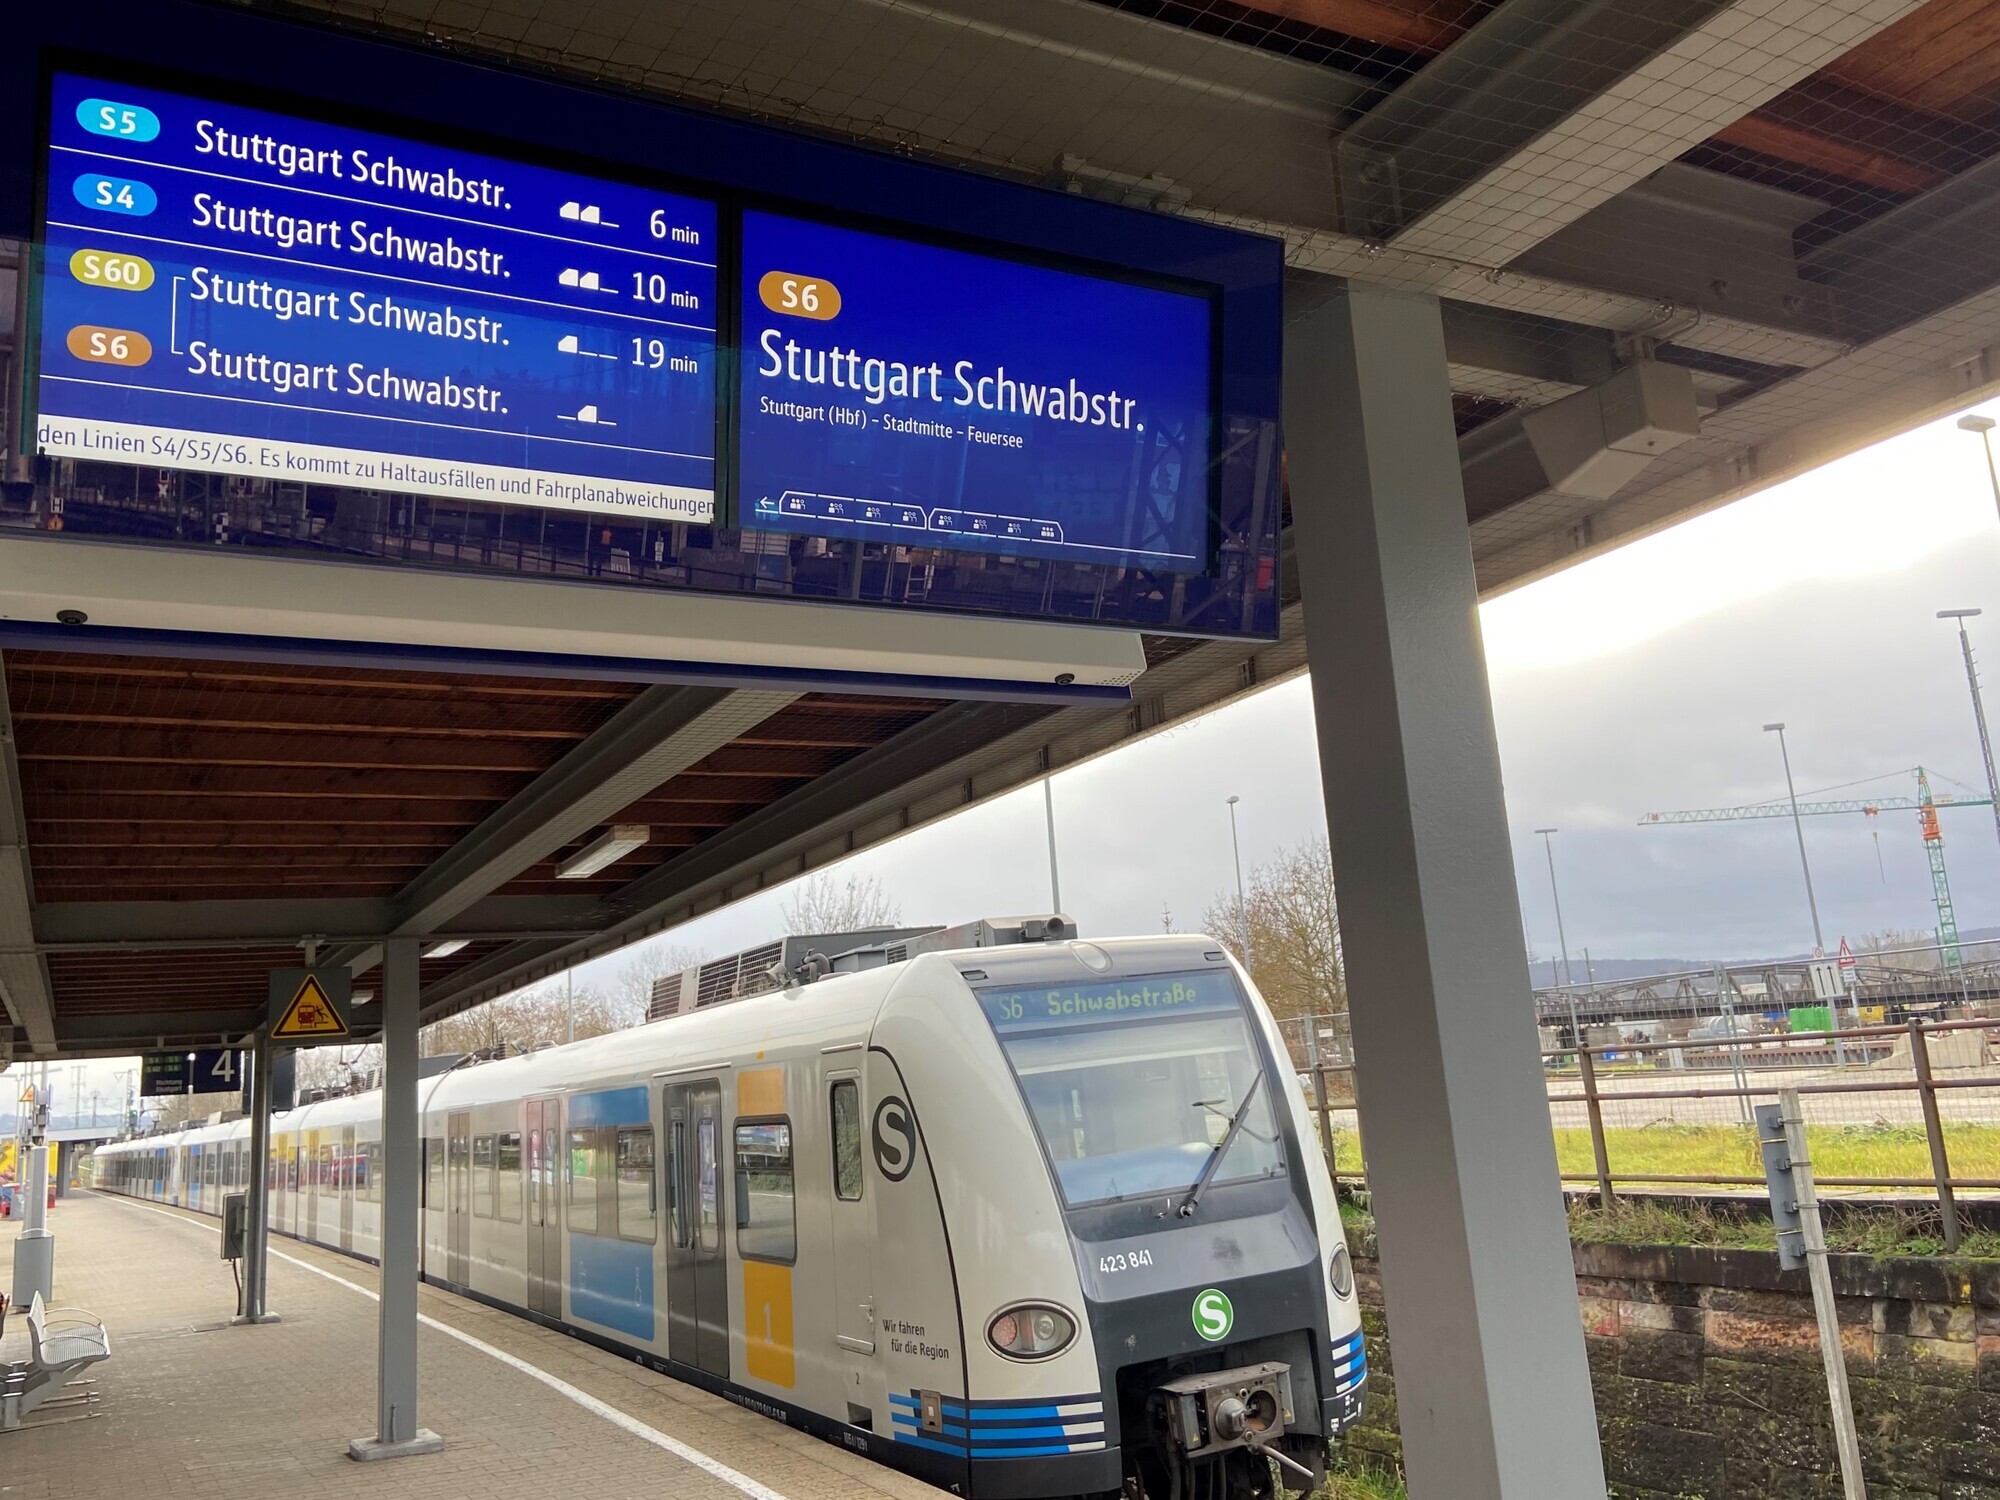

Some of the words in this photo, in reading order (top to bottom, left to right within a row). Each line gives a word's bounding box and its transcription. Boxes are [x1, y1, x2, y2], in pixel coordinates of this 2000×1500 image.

[100, 106, 136, 134] S5
[195, 119, 343, 178] Stuttgart
[351, 150, 512, 210] Schwabstr.
[96, 181, 135, 209] S4
[192, 193, 343, 249] Stuttgart
[349, 220, 511, 278] Schwabstr.
[650, 209, 667, 239] 6
[671, 227, 699, 245] min
[83, 255, 142, 287] S60
[190, 266, 340, 321] Stuttgart
[348, 292, 510, 346] Schwabstr.
[632, 272, 666, 304] 10
[671, 290, 699, 310] min
[781, 279, 820, 313] S6
[89, 332, 129, 360] S6
[632, 336, 665, 369] 19
[670, 355, 698, 374] min
[188, 340, 338, 393] Stuttgart
[346, 362, 508, 414] Schwabstr.
[759, 328, 943, 404] Stuttgart
[953, 360, 1145, 432] Schwabstr.
[760, 395, 825, 423] Stuttgart
[828, 404, 868, 430] (Hbf)
[883, 413, 953, 439] Stadtmitte
[968, 425, 1024, 448] Feuersee
[38, 424, 76, 447] den
[83, 428, 145, 453] Linien
[151, 435, 253, 465] S4/S5/S6.
[260, 447, 280, 468] Es
[286, 451, 350, 475] kommt
[355, 464, 375, 479] zu
[381, 461, 495, 492] Haltausfällen
[500, 478, 531, 495] und
[536, 477, 715, 515] Fahrplanabweichungen
[1000, 994, 1023, 1020] S6
[1046, 983, 1197, 1016] Schwabstraße
[211, 1050, 235, 1082] 4
[878, 1103, 910, 1175] S
[1100, 1255, 1127, 1273] 423
[1128, 1249, 1153, 1268] 841
[882, 1319, 897, 1333] Wir
[898, 1320, 925, 1336] fahren
[1199, 1295, 1228, 1335] S
[891, 1338, 903, 1352] für
[904, 1340, 918, 1355] die
[919, 1342, 949, 1361] Region
